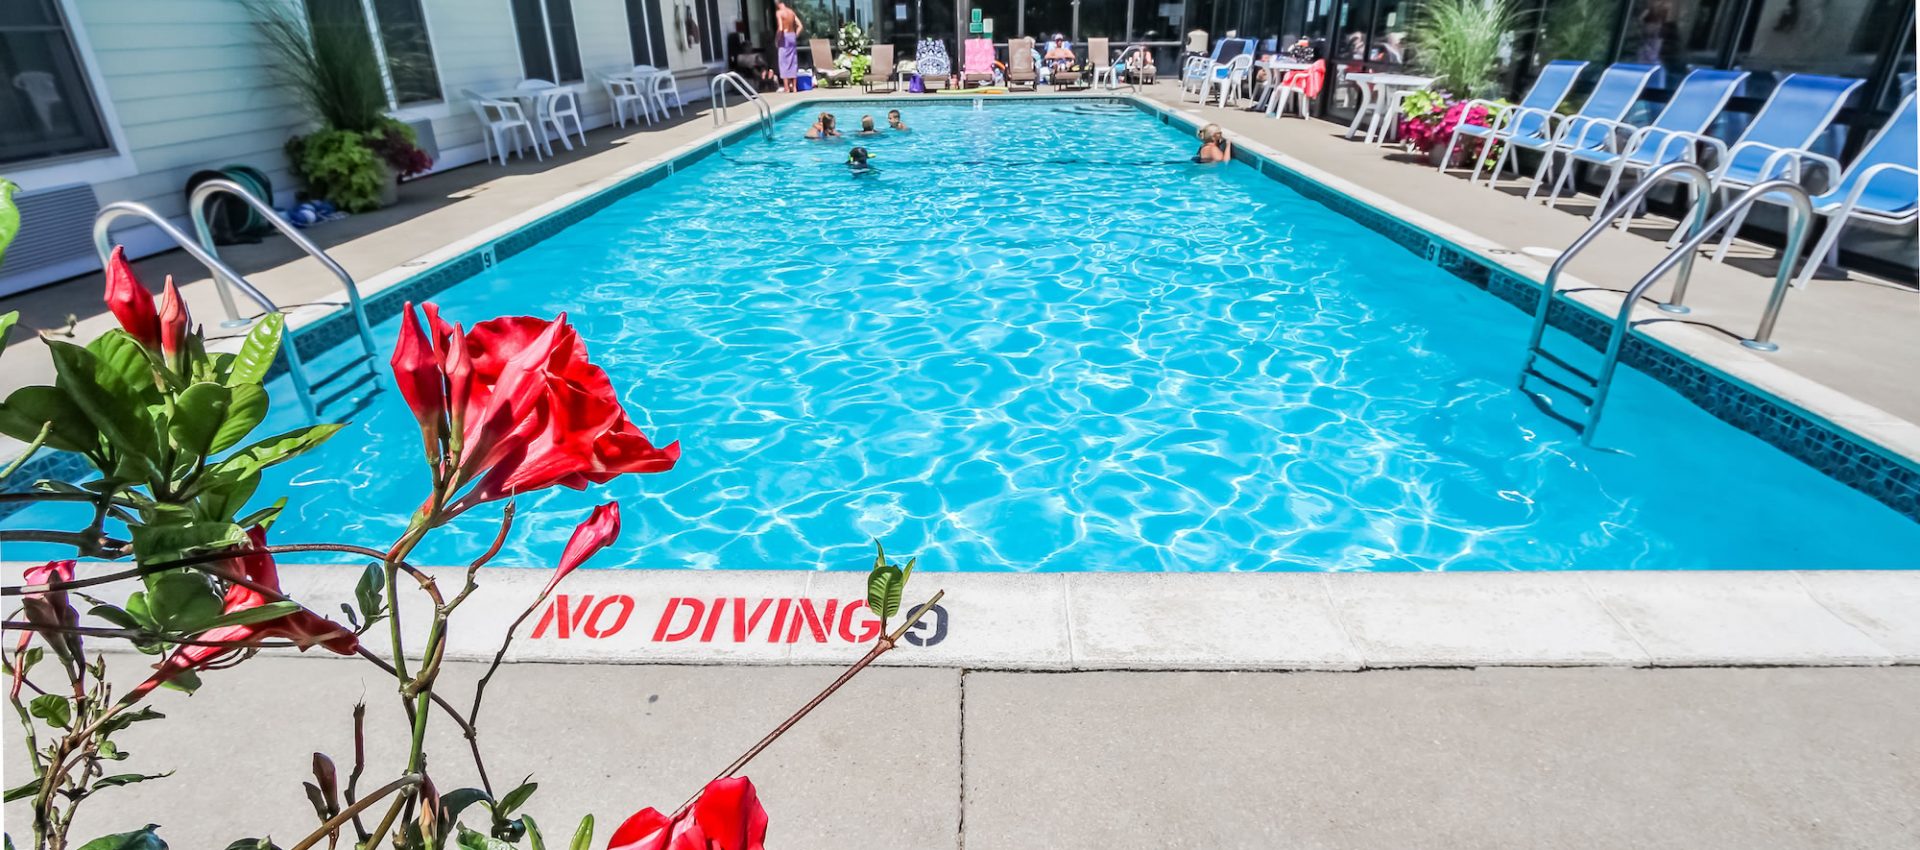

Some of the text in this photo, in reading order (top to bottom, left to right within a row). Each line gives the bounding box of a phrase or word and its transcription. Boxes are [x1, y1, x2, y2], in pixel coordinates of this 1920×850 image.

[483, 252, 492, 268] 9
[1427, 243, 1435, 261] 9
[530, 594, 949, 647] NO DIVING 9
